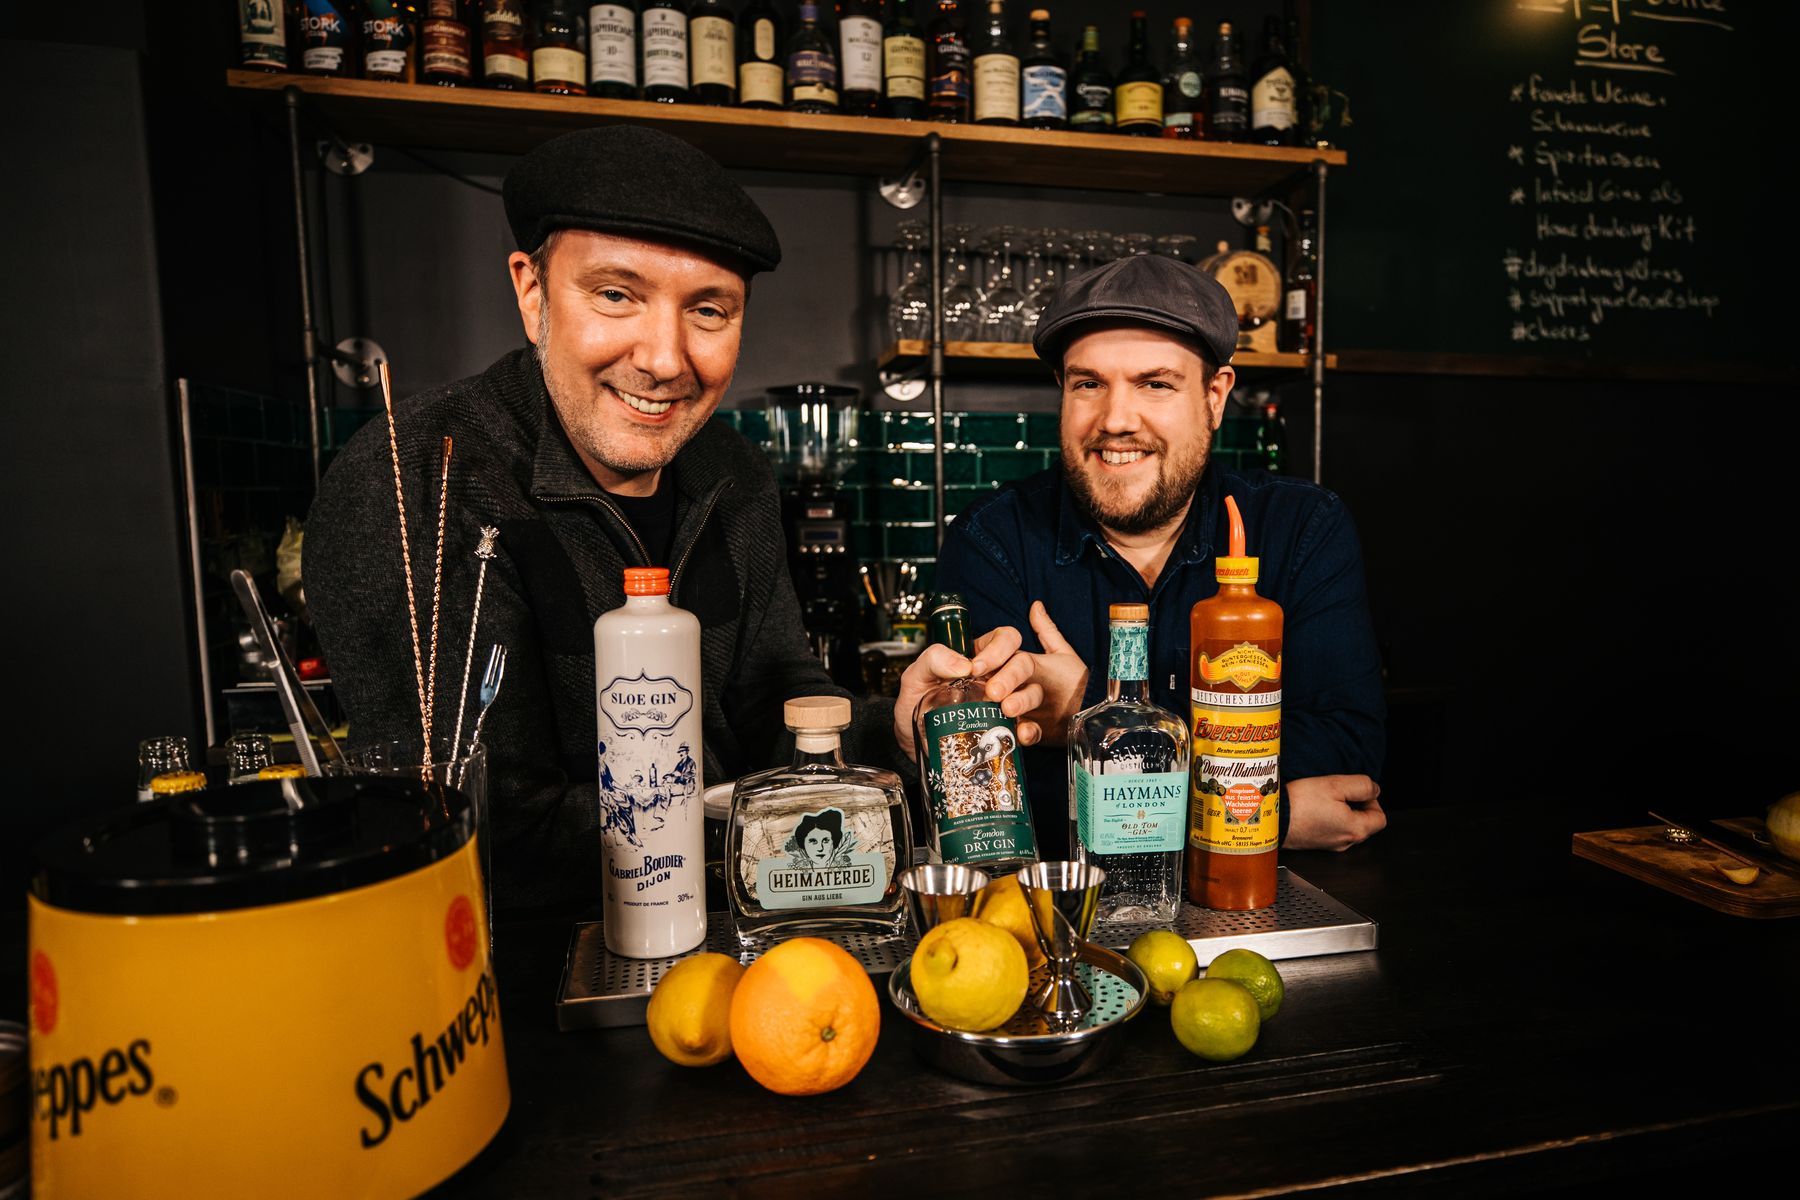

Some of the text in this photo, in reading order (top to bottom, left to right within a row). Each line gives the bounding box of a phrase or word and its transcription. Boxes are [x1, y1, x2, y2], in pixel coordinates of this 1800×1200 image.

[299, 17, 342, 34] STORK
[362, 19, 405, 37] STORK
[1577, 23, 1666, 63] Store
[611, 692, 677, 706] SLOE GIN
[1196, 690, 1245, 705] DEUTSCHES
[957, 719, 989, 731] London
[1103, 785, 1182, 801] HAYMANS
[1122, 801, 1166, 809] LONDON
[972, 828, 1005, 840] London
[964, 839, 1015, 854] DRY GIN
[608, 854, 683, 880] GABRIEL BOUDIER
[636, 871, 671, 892] DIJON
[774, 868, 870, 888] HEIMATERDE
